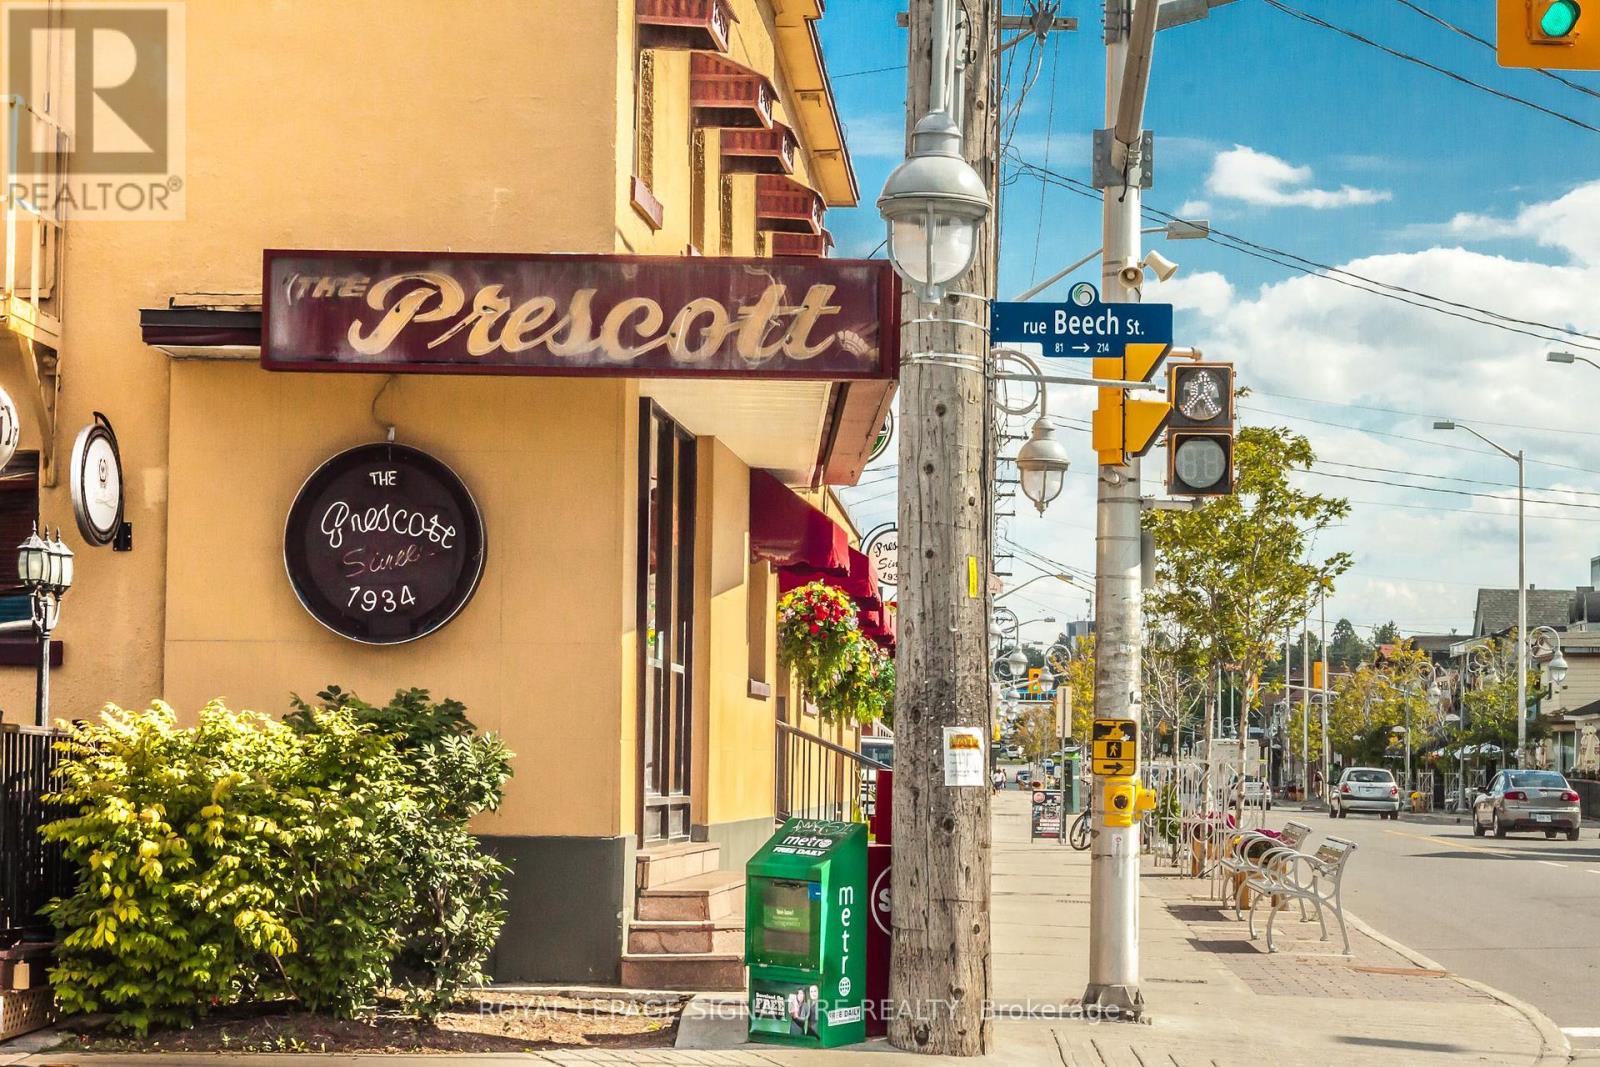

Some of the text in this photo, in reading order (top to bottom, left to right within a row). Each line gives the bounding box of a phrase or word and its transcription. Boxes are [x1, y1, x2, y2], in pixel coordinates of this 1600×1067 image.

[347, 272, 842, 364] Prescott
[1023, 308, 1145, 335] rue Beech St.
[1055, 343, 1109, 353] 81 214
[369, 470, 398, 486] THE
[321, 501, 456, 549] Prescott
[347, 585, 416, 612] 1934
[782, 835, 833, 849] metro
[838, 885, 854, 997] metro
